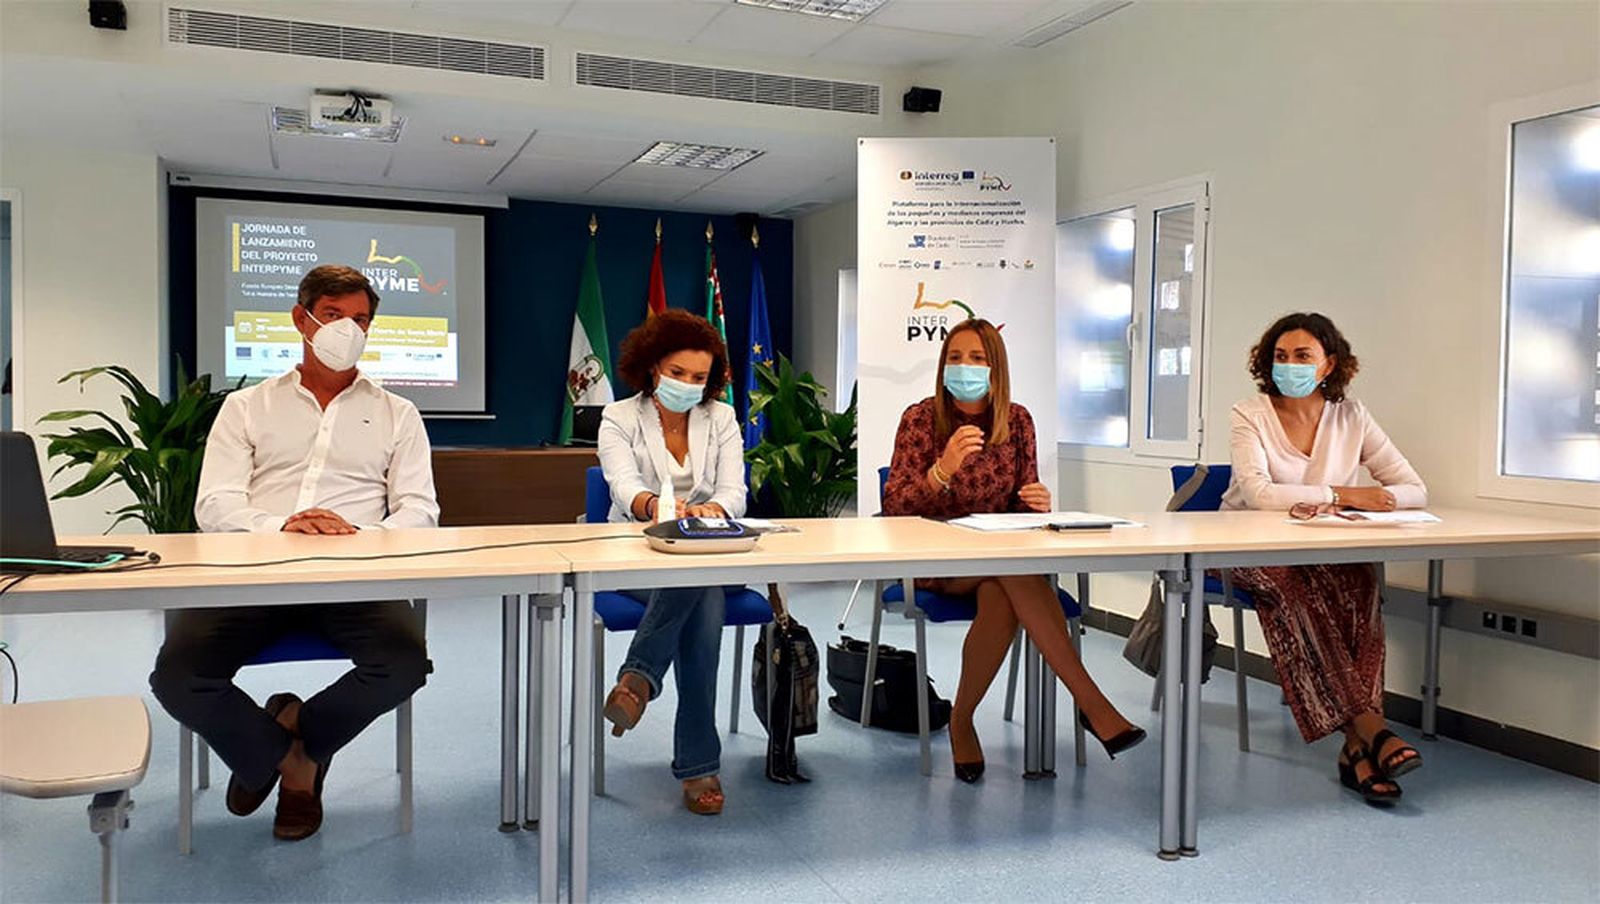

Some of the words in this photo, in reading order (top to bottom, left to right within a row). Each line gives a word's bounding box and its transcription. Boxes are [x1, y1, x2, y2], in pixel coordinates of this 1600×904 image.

[241, 223, 291, 234] JORNADA
[292, 225, 307, 236] DE
[241, 237, 316, 249] LANZAMIENTO
[241, 250, 261, 260] DEL
[263, 251, 318, 262] PROYECTO
[241, 263, 303, 276] INTERPYME
[362, 267, 398, 278] INTER
[368, 276, 420, 292] PYME
[907, 315, 948, 326] INTER
